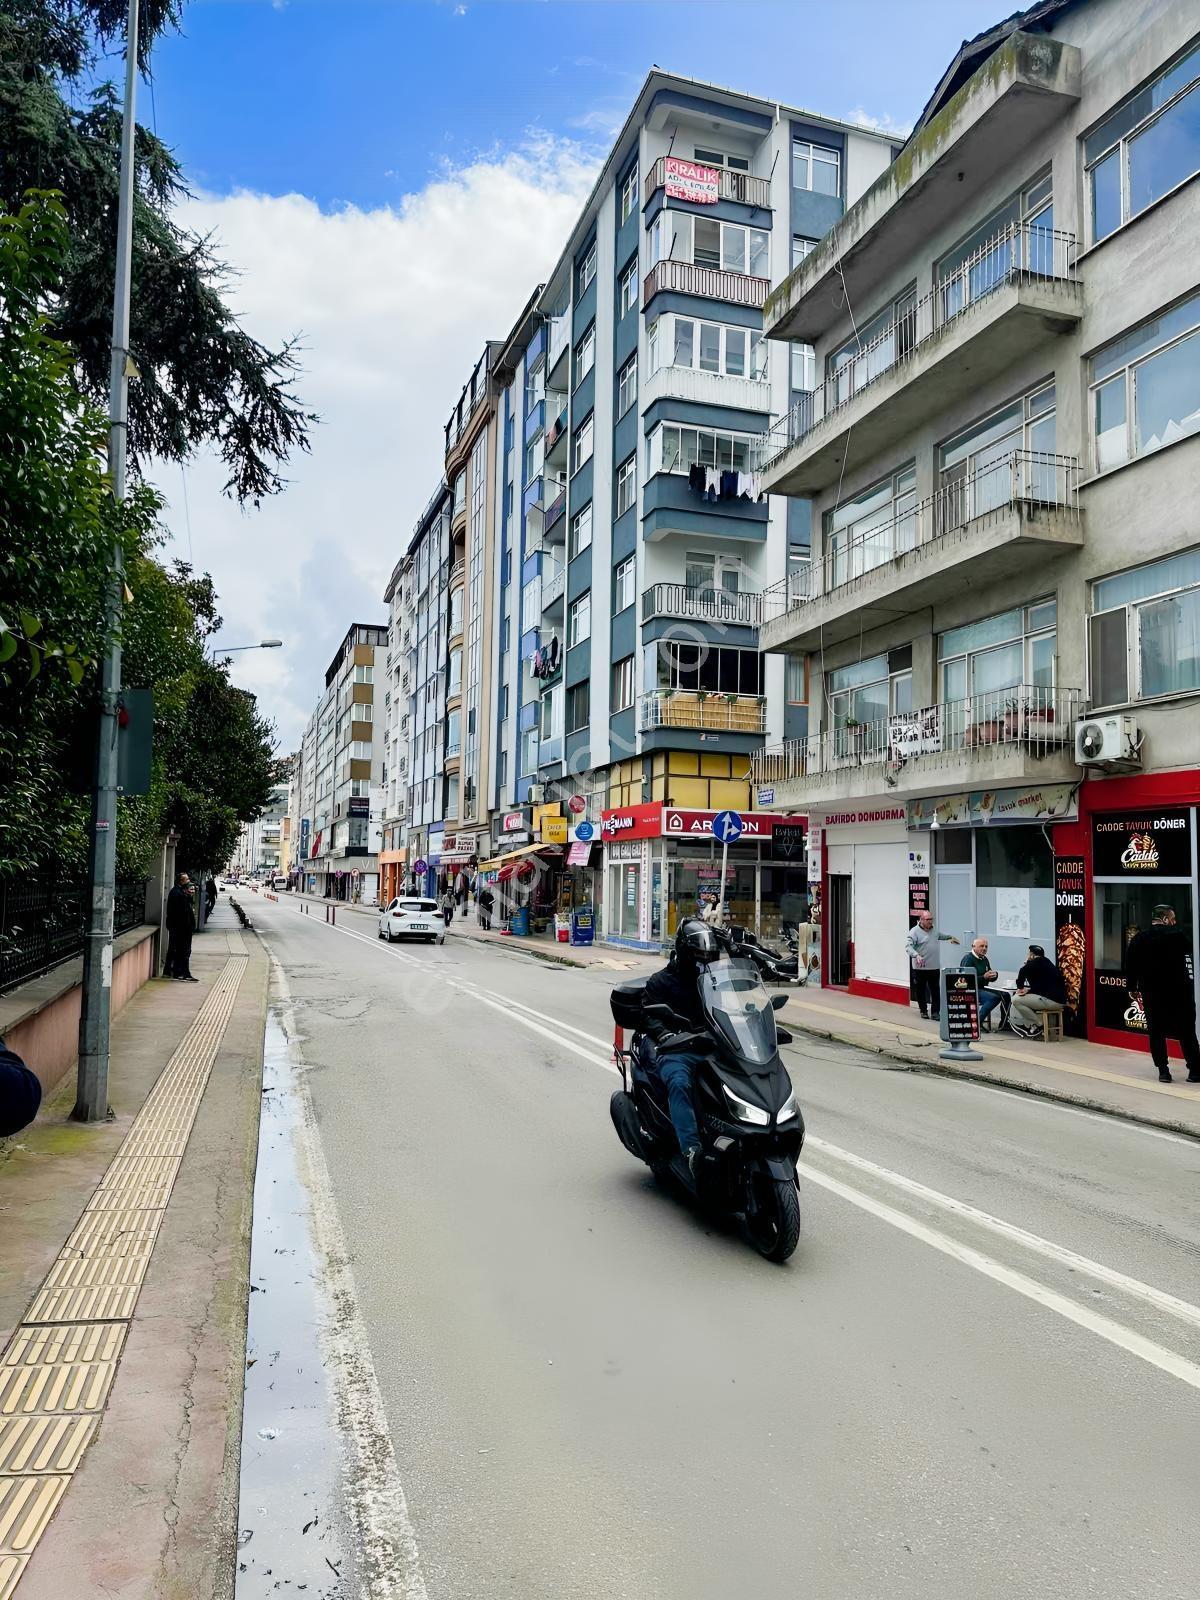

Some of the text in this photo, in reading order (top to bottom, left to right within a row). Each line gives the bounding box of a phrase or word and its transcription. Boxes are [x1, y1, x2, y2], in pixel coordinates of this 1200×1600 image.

[667, 160, 717, 184] KIRALIK
[1017, 792, 1043, 808] market
[858, 808, 905, 822] DONDURMA
[1096, 817, 1186, 832] CADDE TAVUK DÖNER
[1121, 848, 1160, 864] Cadde
[1056, 862, 1084, 874] CADDE
[1057, 878, 1084, 890] TAVUK
[1056, 890, 1085, 907] DÖNER
[1099, 975, 1127, 988] CADDE
